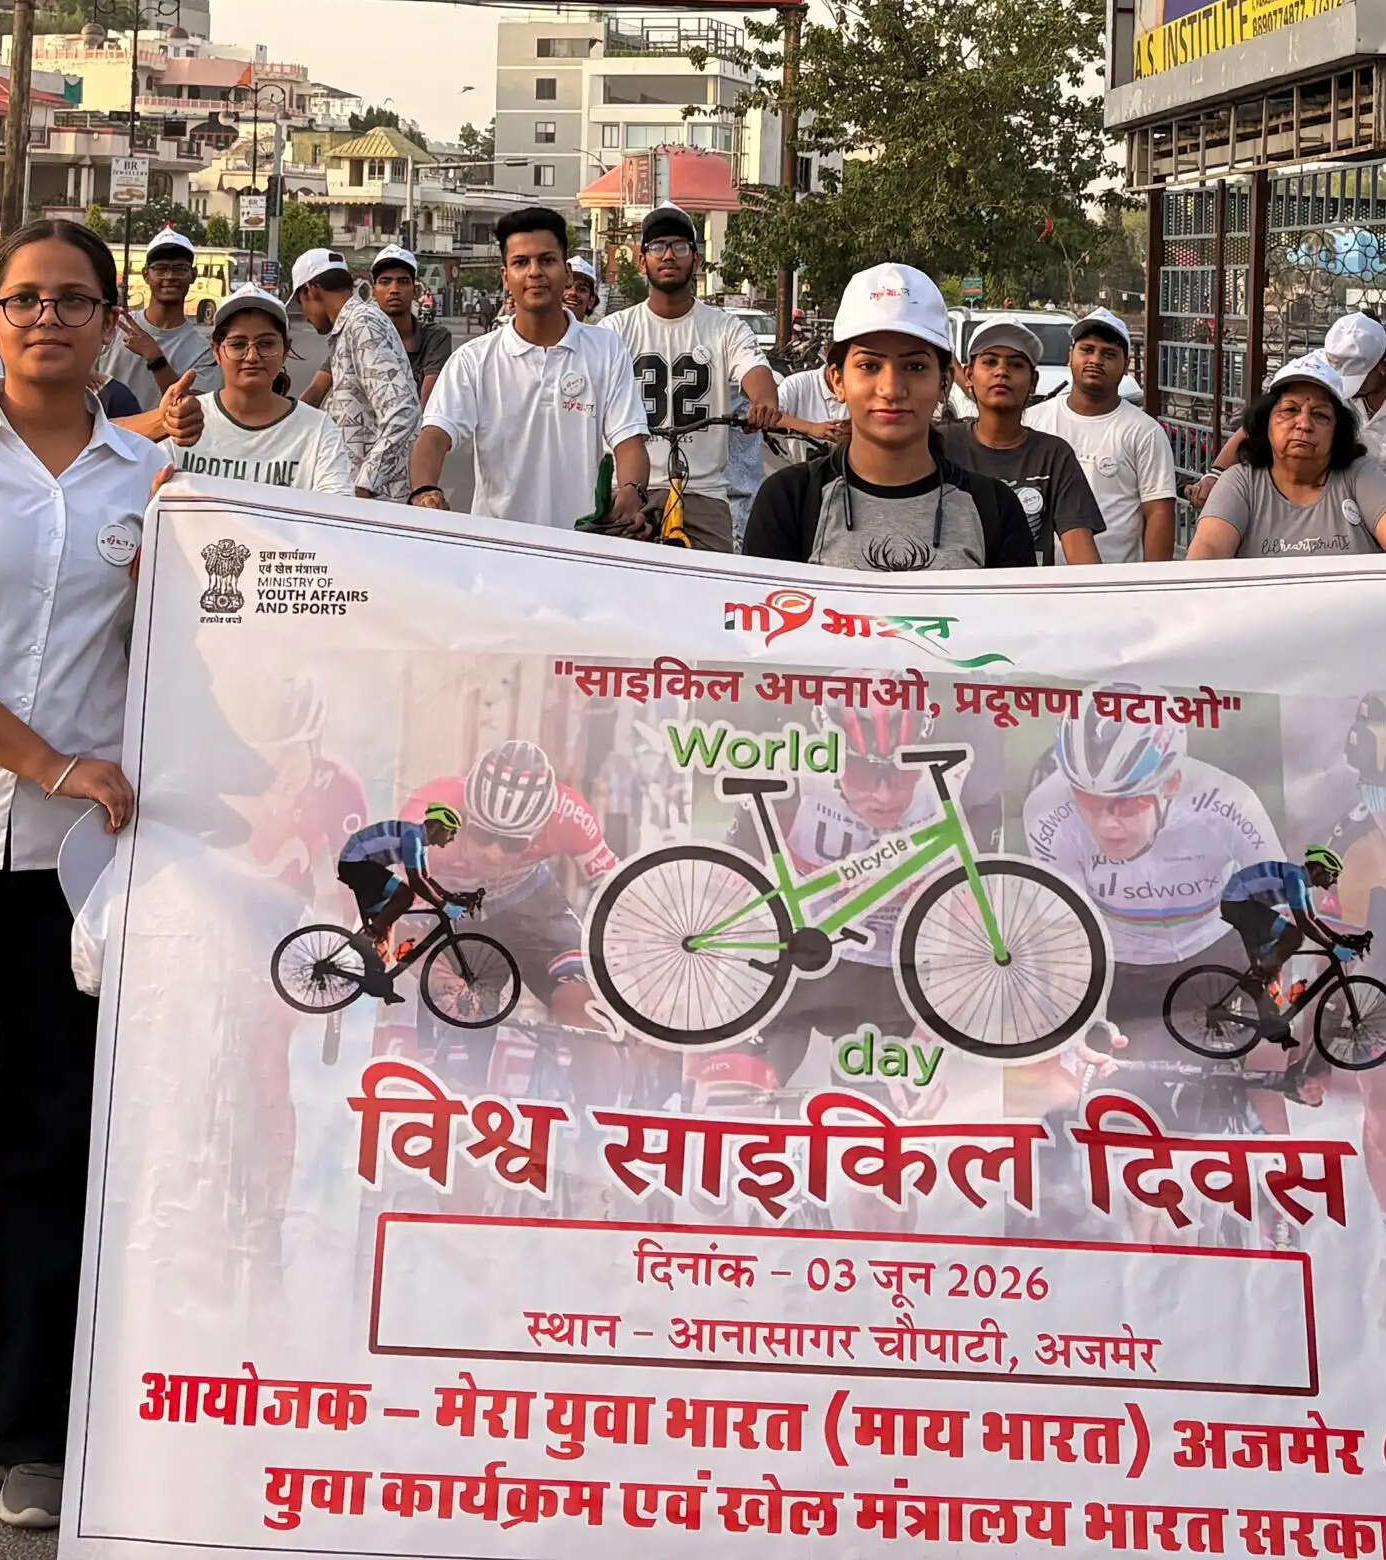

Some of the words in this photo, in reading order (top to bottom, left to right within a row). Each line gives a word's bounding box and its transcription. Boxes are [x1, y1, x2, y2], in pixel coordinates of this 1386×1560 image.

[1134, 33, 1158, 81] A.S.
[124, 160, 138, 170] BR
[632, 352, 711, 431] 32
[255, 603, 288, 614] AND
[292, 604, 347, 615] SPORTS
[256, 589, 306, 602] YOUTH
[310, 590, 369, 602] AFFAIRS
[258, 577, 314, 588] MINISTRY
[317, 578, 334, 588] OF
[554, 656, 744, 704] "साइकिल
[755, 668, 942, 719] अपनाओ,
[953, 683, 1083, 727] प्रदूषण
[665, 724, 839, 774] World
[1211, 798, 1265, 851] sdworx
[840, 838, 908, 881] bicycle
[1124, 876, 1220, 900] sdworx
[838, 1031, 944, 1086] day
[347, 1061, 570, 1194] विश्व
[592, 1092, 1049, 1220] साइकिल
[1070, 1094, 1358, 1229] दिवस
[633, 1239, 758, 1291] दिनांक
[807, 1258, 857, 1293] 03
[868, 1261, 936, 1308] जून
[948, 1263, 1050, 1301] 2026
[522, 1310, 622, 1350] स्थान
[668, 1314, 861, 1361] आनासागर
[868, 1313, 1020, 1373] चौपाटी,
[1034, 1323, 1163, 1374] अजमेर
[138, 1362, 373, 1431] आयोजक
[435, 1371, 538, 1440] मेरा
[544, 1390, 657, 1461] युवा
[665, 1396, 809, 1453] भारत
[824, 1389, 970, 1467] (माय
[981, 1402, 1149, 1479] भारत)
[1172, 1409, 1365, 1476] अजमेर
[262, 1465, 373, 1532] युवा
[380, 1460, 611, 1531] कार्यक्रम
[620, 1470, 709, 1531] एवं
[717, 1473, 844, 1537] खेल
[855, 1478, 1073, 1547] मंत्रालय
[1084, 1501, 1229, 1554] भारत
